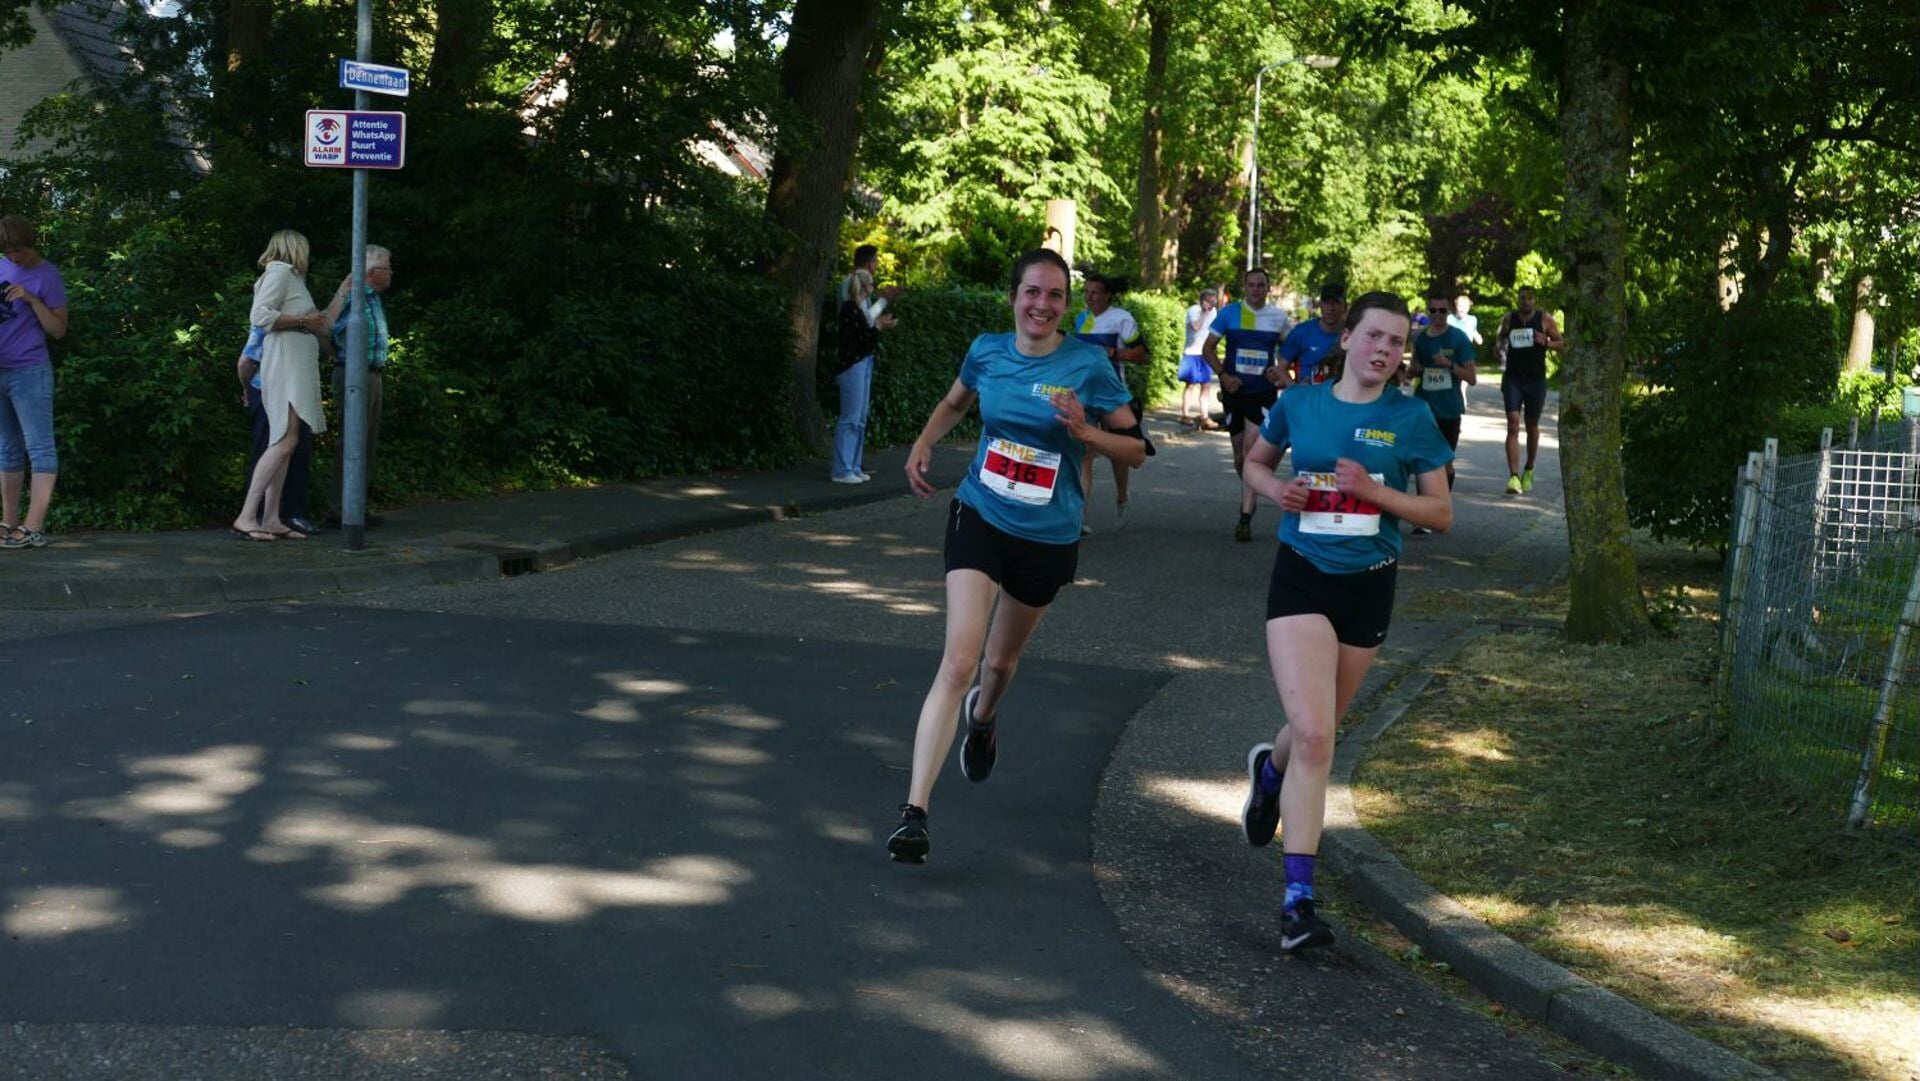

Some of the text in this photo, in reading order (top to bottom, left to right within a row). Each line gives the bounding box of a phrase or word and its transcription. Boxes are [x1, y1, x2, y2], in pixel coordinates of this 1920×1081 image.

[348, 66, 405, 89] Dennenlaan
[352, 120, 389, 129] Attentie
[351, 130, 397, 142] WhatsApp
[351, 142, 377, 150] Buurt
[351, 152, 393, 161] Preventie
[1000, 456, 1038, 484] 316
